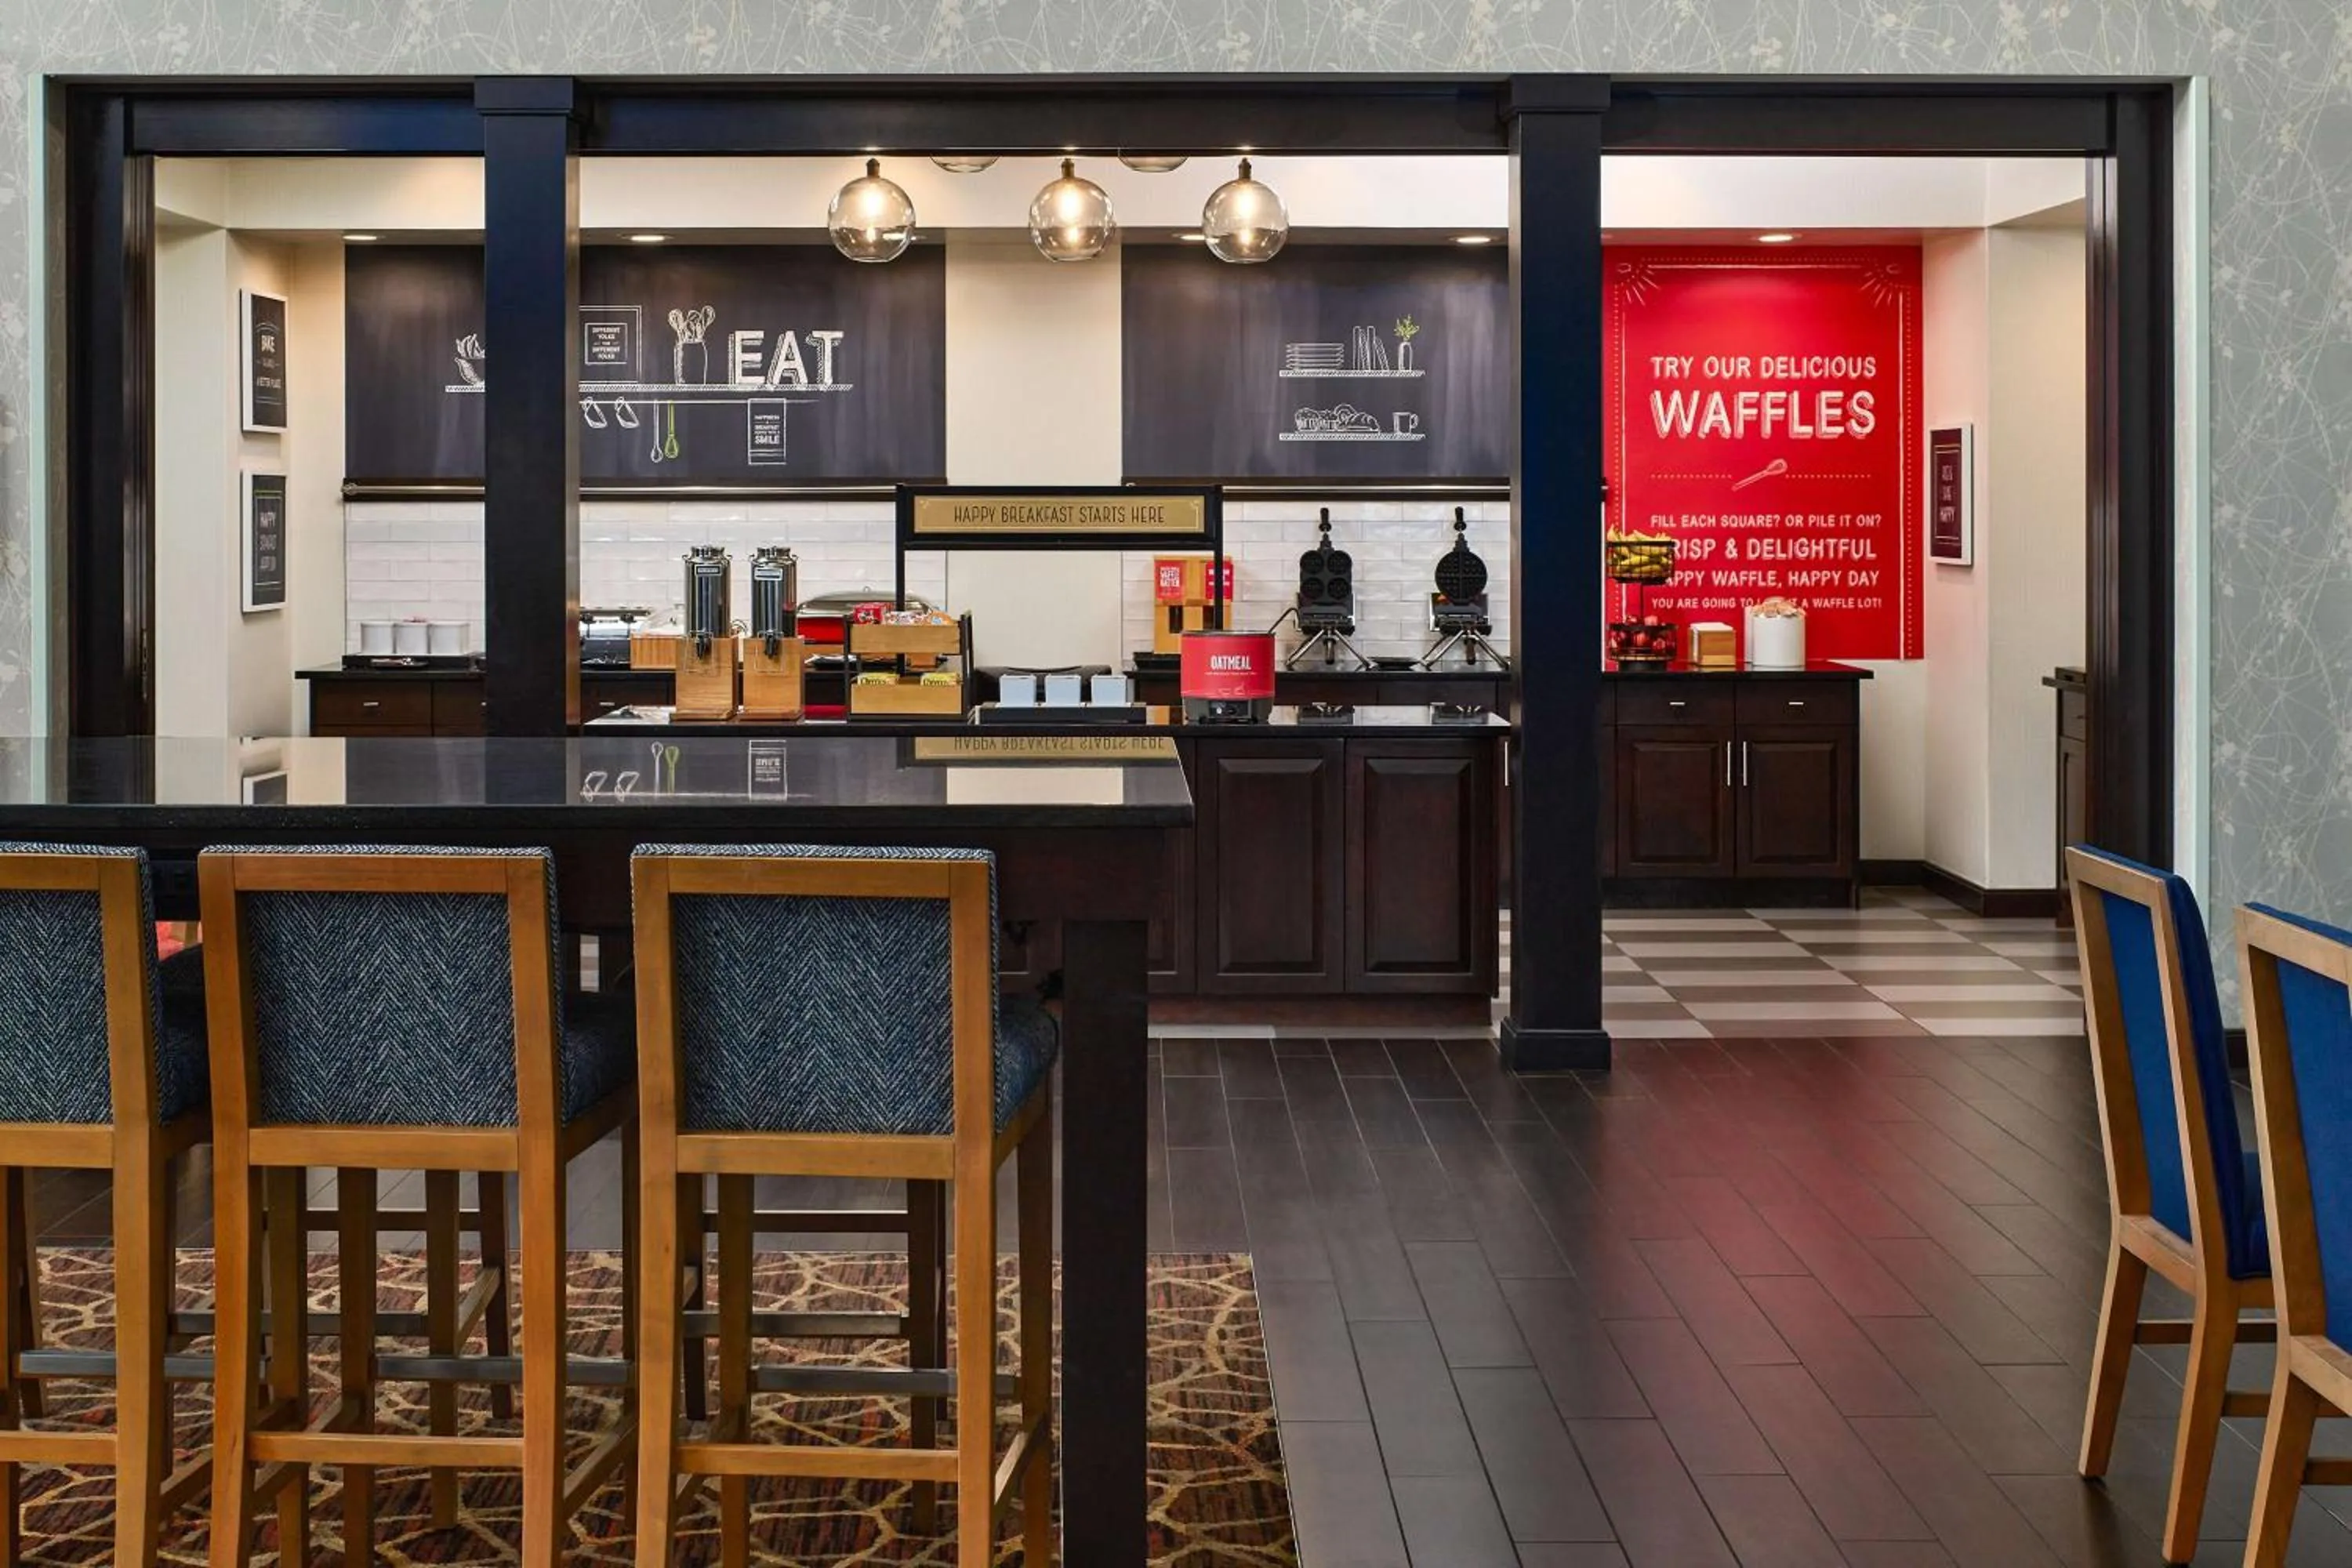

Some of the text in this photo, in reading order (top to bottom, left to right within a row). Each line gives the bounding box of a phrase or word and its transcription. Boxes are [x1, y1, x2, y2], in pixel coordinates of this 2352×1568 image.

[728, 330, 844, 385] EAT
[1650, 356, 1876, 379] TRY OUR DELICIOUS
[1650, 390, 1875, 440] WAFFLES
[954, 506, 1164, 524] HAPPY BREAKFAST STARTS HERE
[1650, 514, 1882, 528] FILL EACH SQUARE? OR PILE IT ON?
[1671, 537, 1877, 560] RISP & DELIGHTFUL
[1711, 570, 1782, 588] WAFFLE,
[1788, 570, 1842, 587] HAPPY
[1848, 570, 1879, 587] DAY
[1652, 597, 1674, 609] YOU
[1677, 597, 1698, 609] ARE
[1702, 597, 1736, 609] GOING
[1740, 597, 1753, 608] TO
[1802, 598, 1809, 608] A
[1812, 597, 1853, 609] WAFFLE
[1210, 655, 1252, 671] OATMEAL
